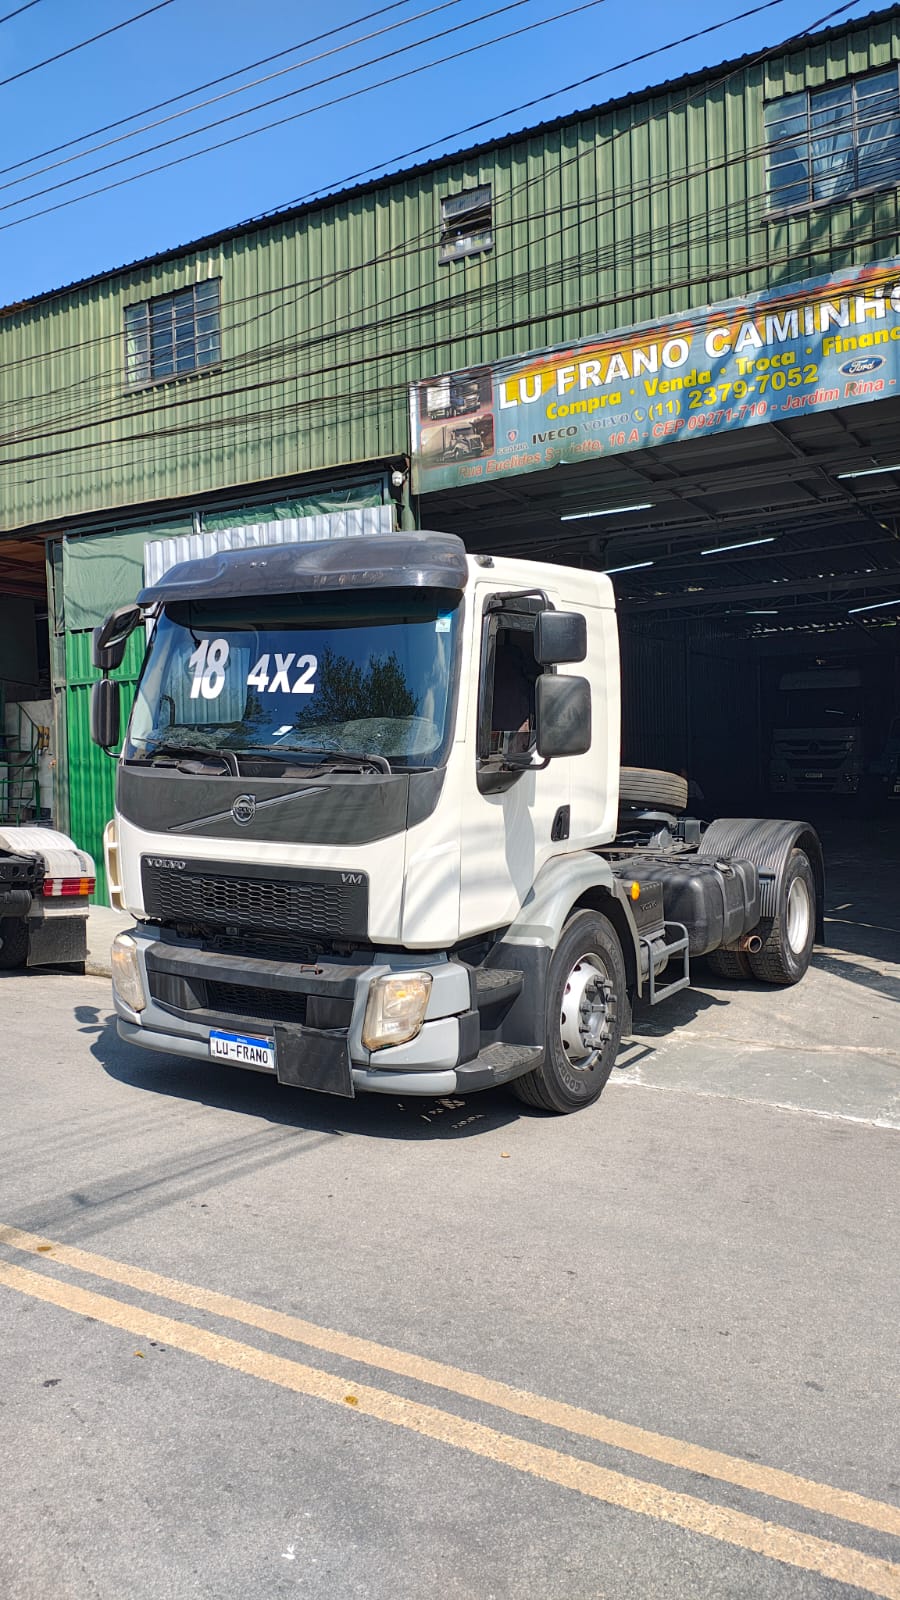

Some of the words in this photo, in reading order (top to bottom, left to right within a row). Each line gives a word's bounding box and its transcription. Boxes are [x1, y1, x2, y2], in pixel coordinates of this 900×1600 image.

[499, 374, 542, 410] LU
[556, 338, 690, 396] FRANO
[546, 391, 622, 420] Compra
[643, 369, 711, 397] Venda
[736, 350, 796, 376] Troca
[648, 399, 681, 421] (11)
[688, 363, 819, 410] 2379-7052
[458, 463, 482, 479] Rua
[486, 452, 542, 474] Euclides
[608, 431, 625, 448] 16
[652, 420, 685, 438] CEP
[687, 402, 767, 430] 09271-710
[781, 387, 840, 411] Jardim
[844, 379, 885, 398] Rina
[532, 425, 578, 444] IVECO
[582, 414, 629, 432] VOLVO
[188, 638, 230, 700] 18
[246, 653, 318, 694] 4X2
[145, 857, 187, 871] VOLVO
[339, 873, 363, 885] VM
[216, 1040, 269, 1064] LU-FRANO
